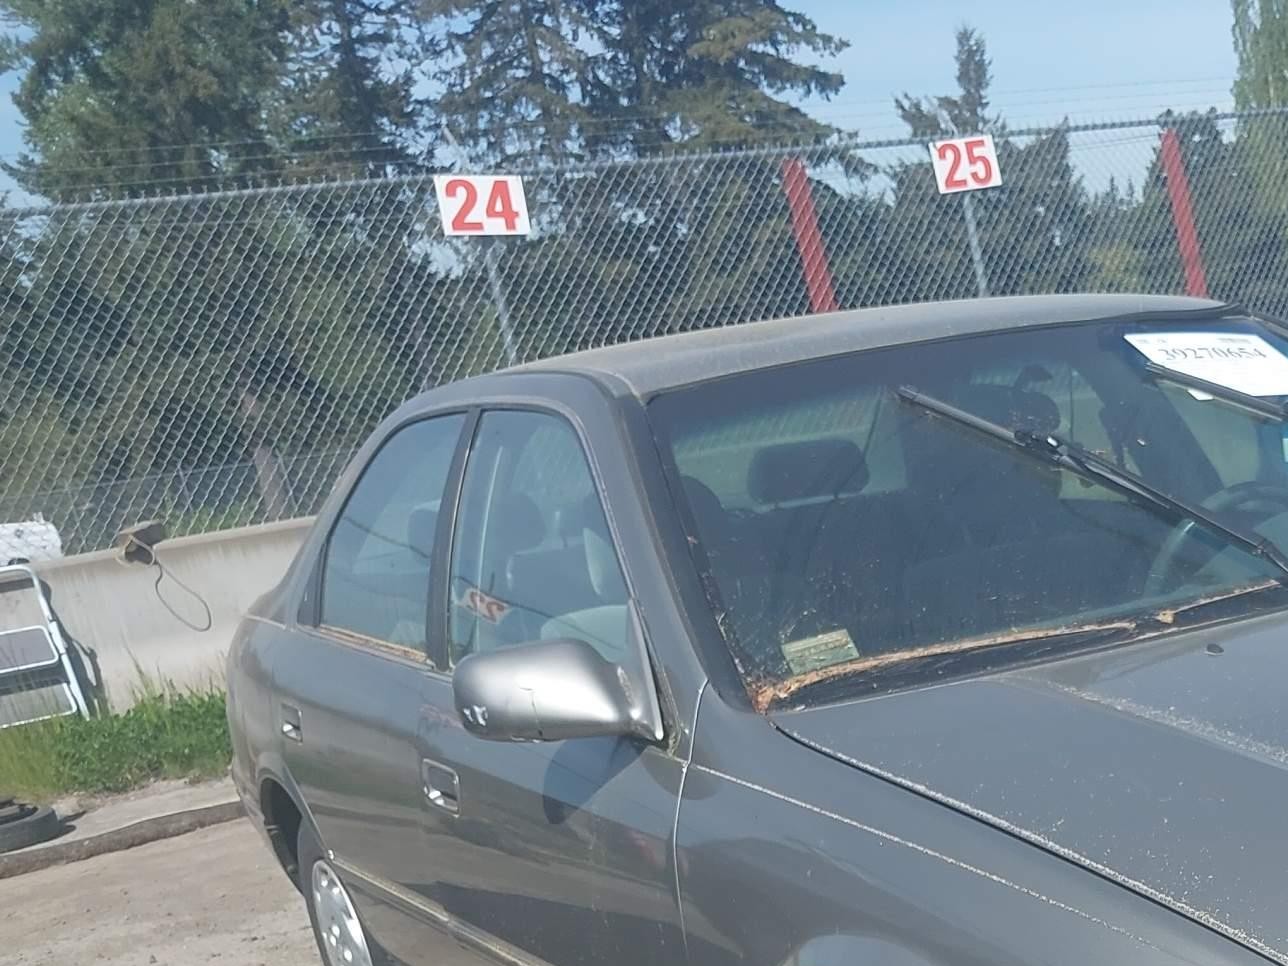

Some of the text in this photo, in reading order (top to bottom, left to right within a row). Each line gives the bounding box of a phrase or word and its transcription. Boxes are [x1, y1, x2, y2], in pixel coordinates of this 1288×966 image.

[938, 140, 992, 188] 25
[446, 179, 519, 231] 24
[1157, 347, 1267, 361] 39270654
